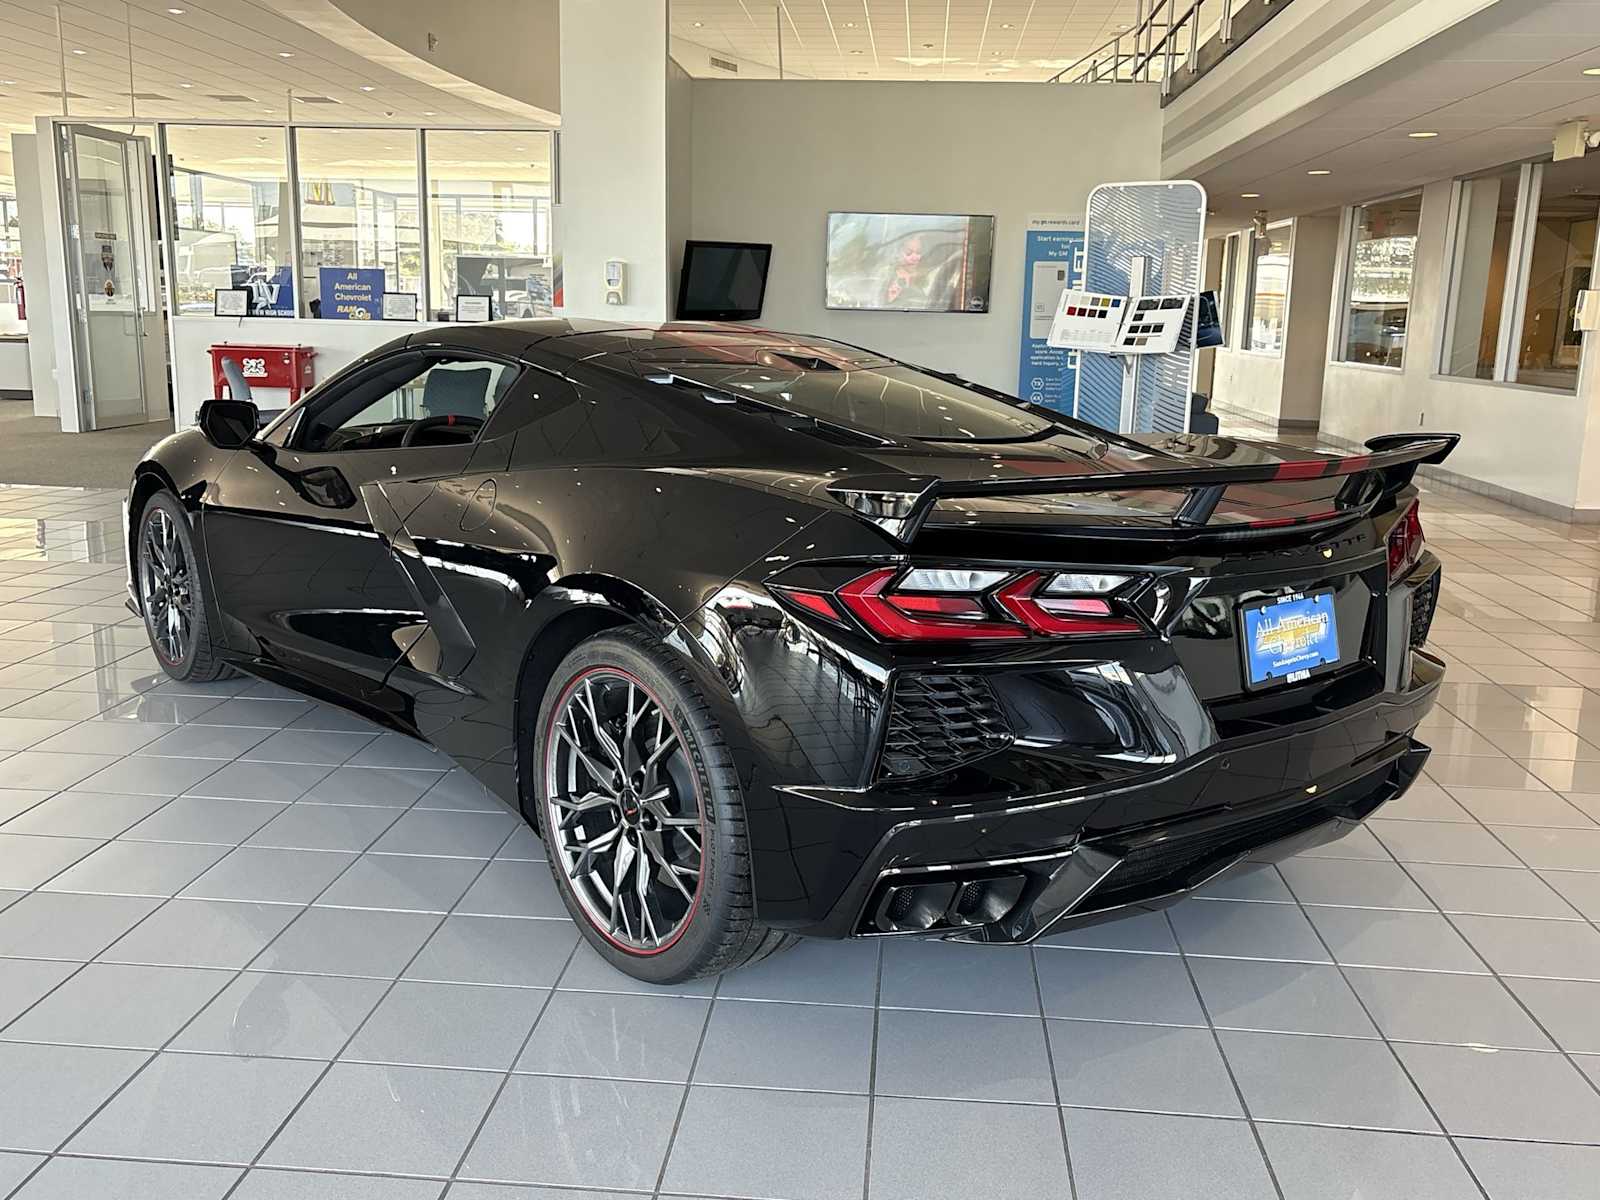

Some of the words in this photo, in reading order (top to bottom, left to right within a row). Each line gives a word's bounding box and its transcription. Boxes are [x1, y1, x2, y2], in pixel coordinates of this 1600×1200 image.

[347, 272, 358, 280] All
[334, 282, 372, 291] American
[334, 293, 372, 302] Chevrolet
[336, 305, 357, 313] RAM
[1277, 594, 1292, 604] SINCE
[1256, 617, 1273, 638] All
[1279, 611, 1329, 631] American
[684, 728, 715, 819] MICHELIN
